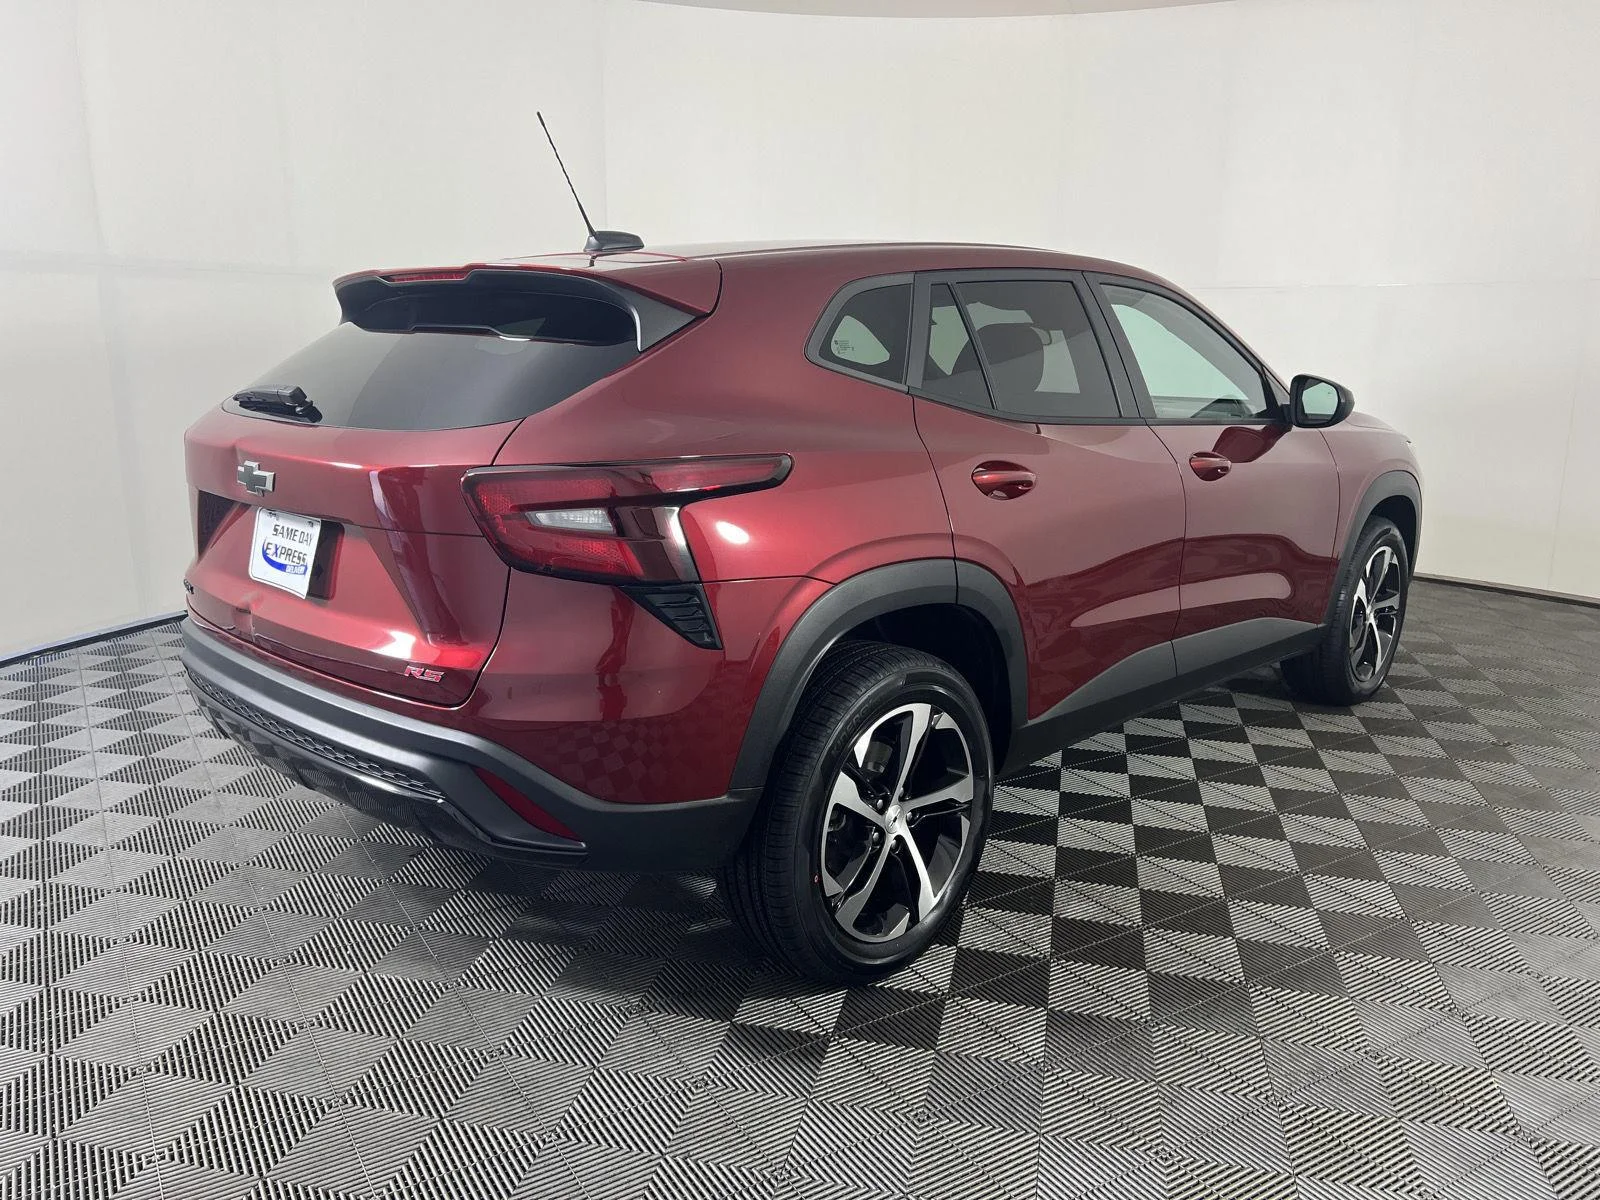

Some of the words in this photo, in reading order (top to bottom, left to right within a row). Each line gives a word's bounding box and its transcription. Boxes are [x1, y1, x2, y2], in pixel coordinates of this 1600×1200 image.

[272, 524, 298, 542] SAME
[298, 531, 313, 547] DAY
[265, 542, 308, 565] EXPRESS
[404, 665, 445, 683] RS
